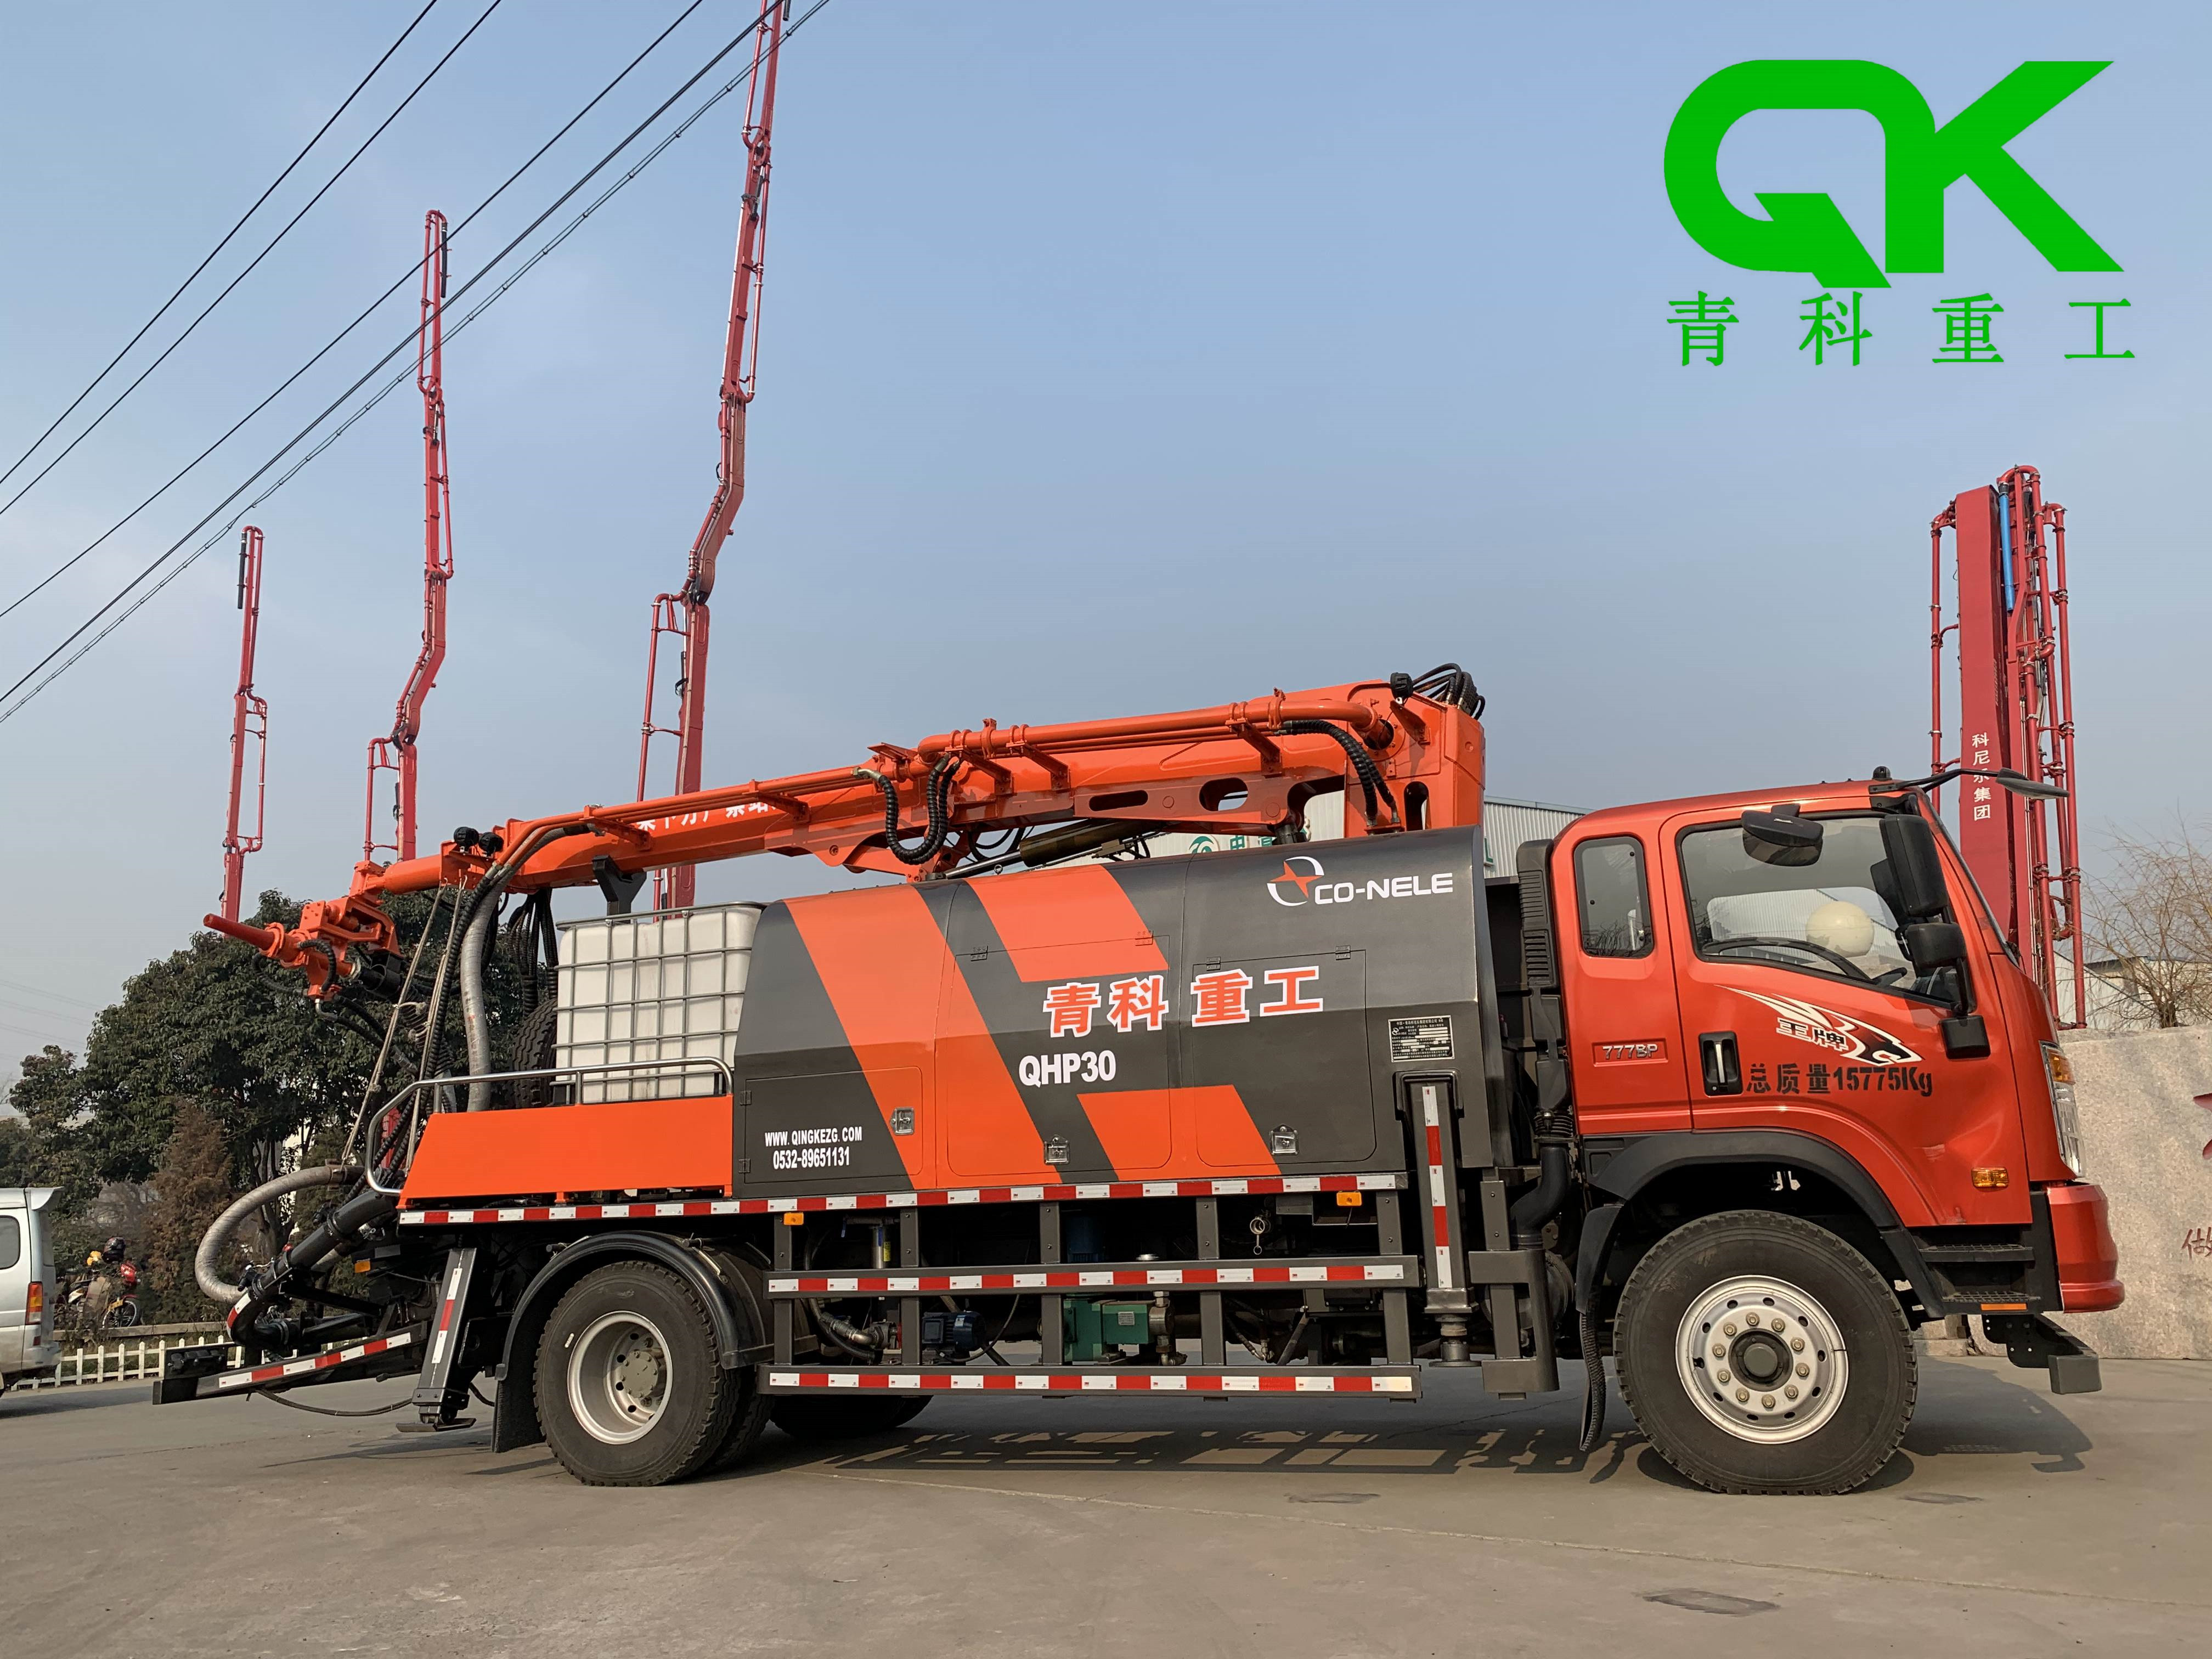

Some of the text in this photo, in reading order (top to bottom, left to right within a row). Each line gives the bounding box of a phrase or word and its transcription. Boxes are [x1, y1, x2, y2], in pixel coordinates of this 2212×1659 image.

[1314, 872, 1453, 905] CO-NELE
[1042, 965, 1324, 1038] 青科重工
[1602, 1043, 1658, 1060] 777BP
[1776, 1017, 1849, 1052] 王牌
[1019, 1050, 1116, 1088] QHP30
[772, 1146, 850, 1170] 0532-89651131
